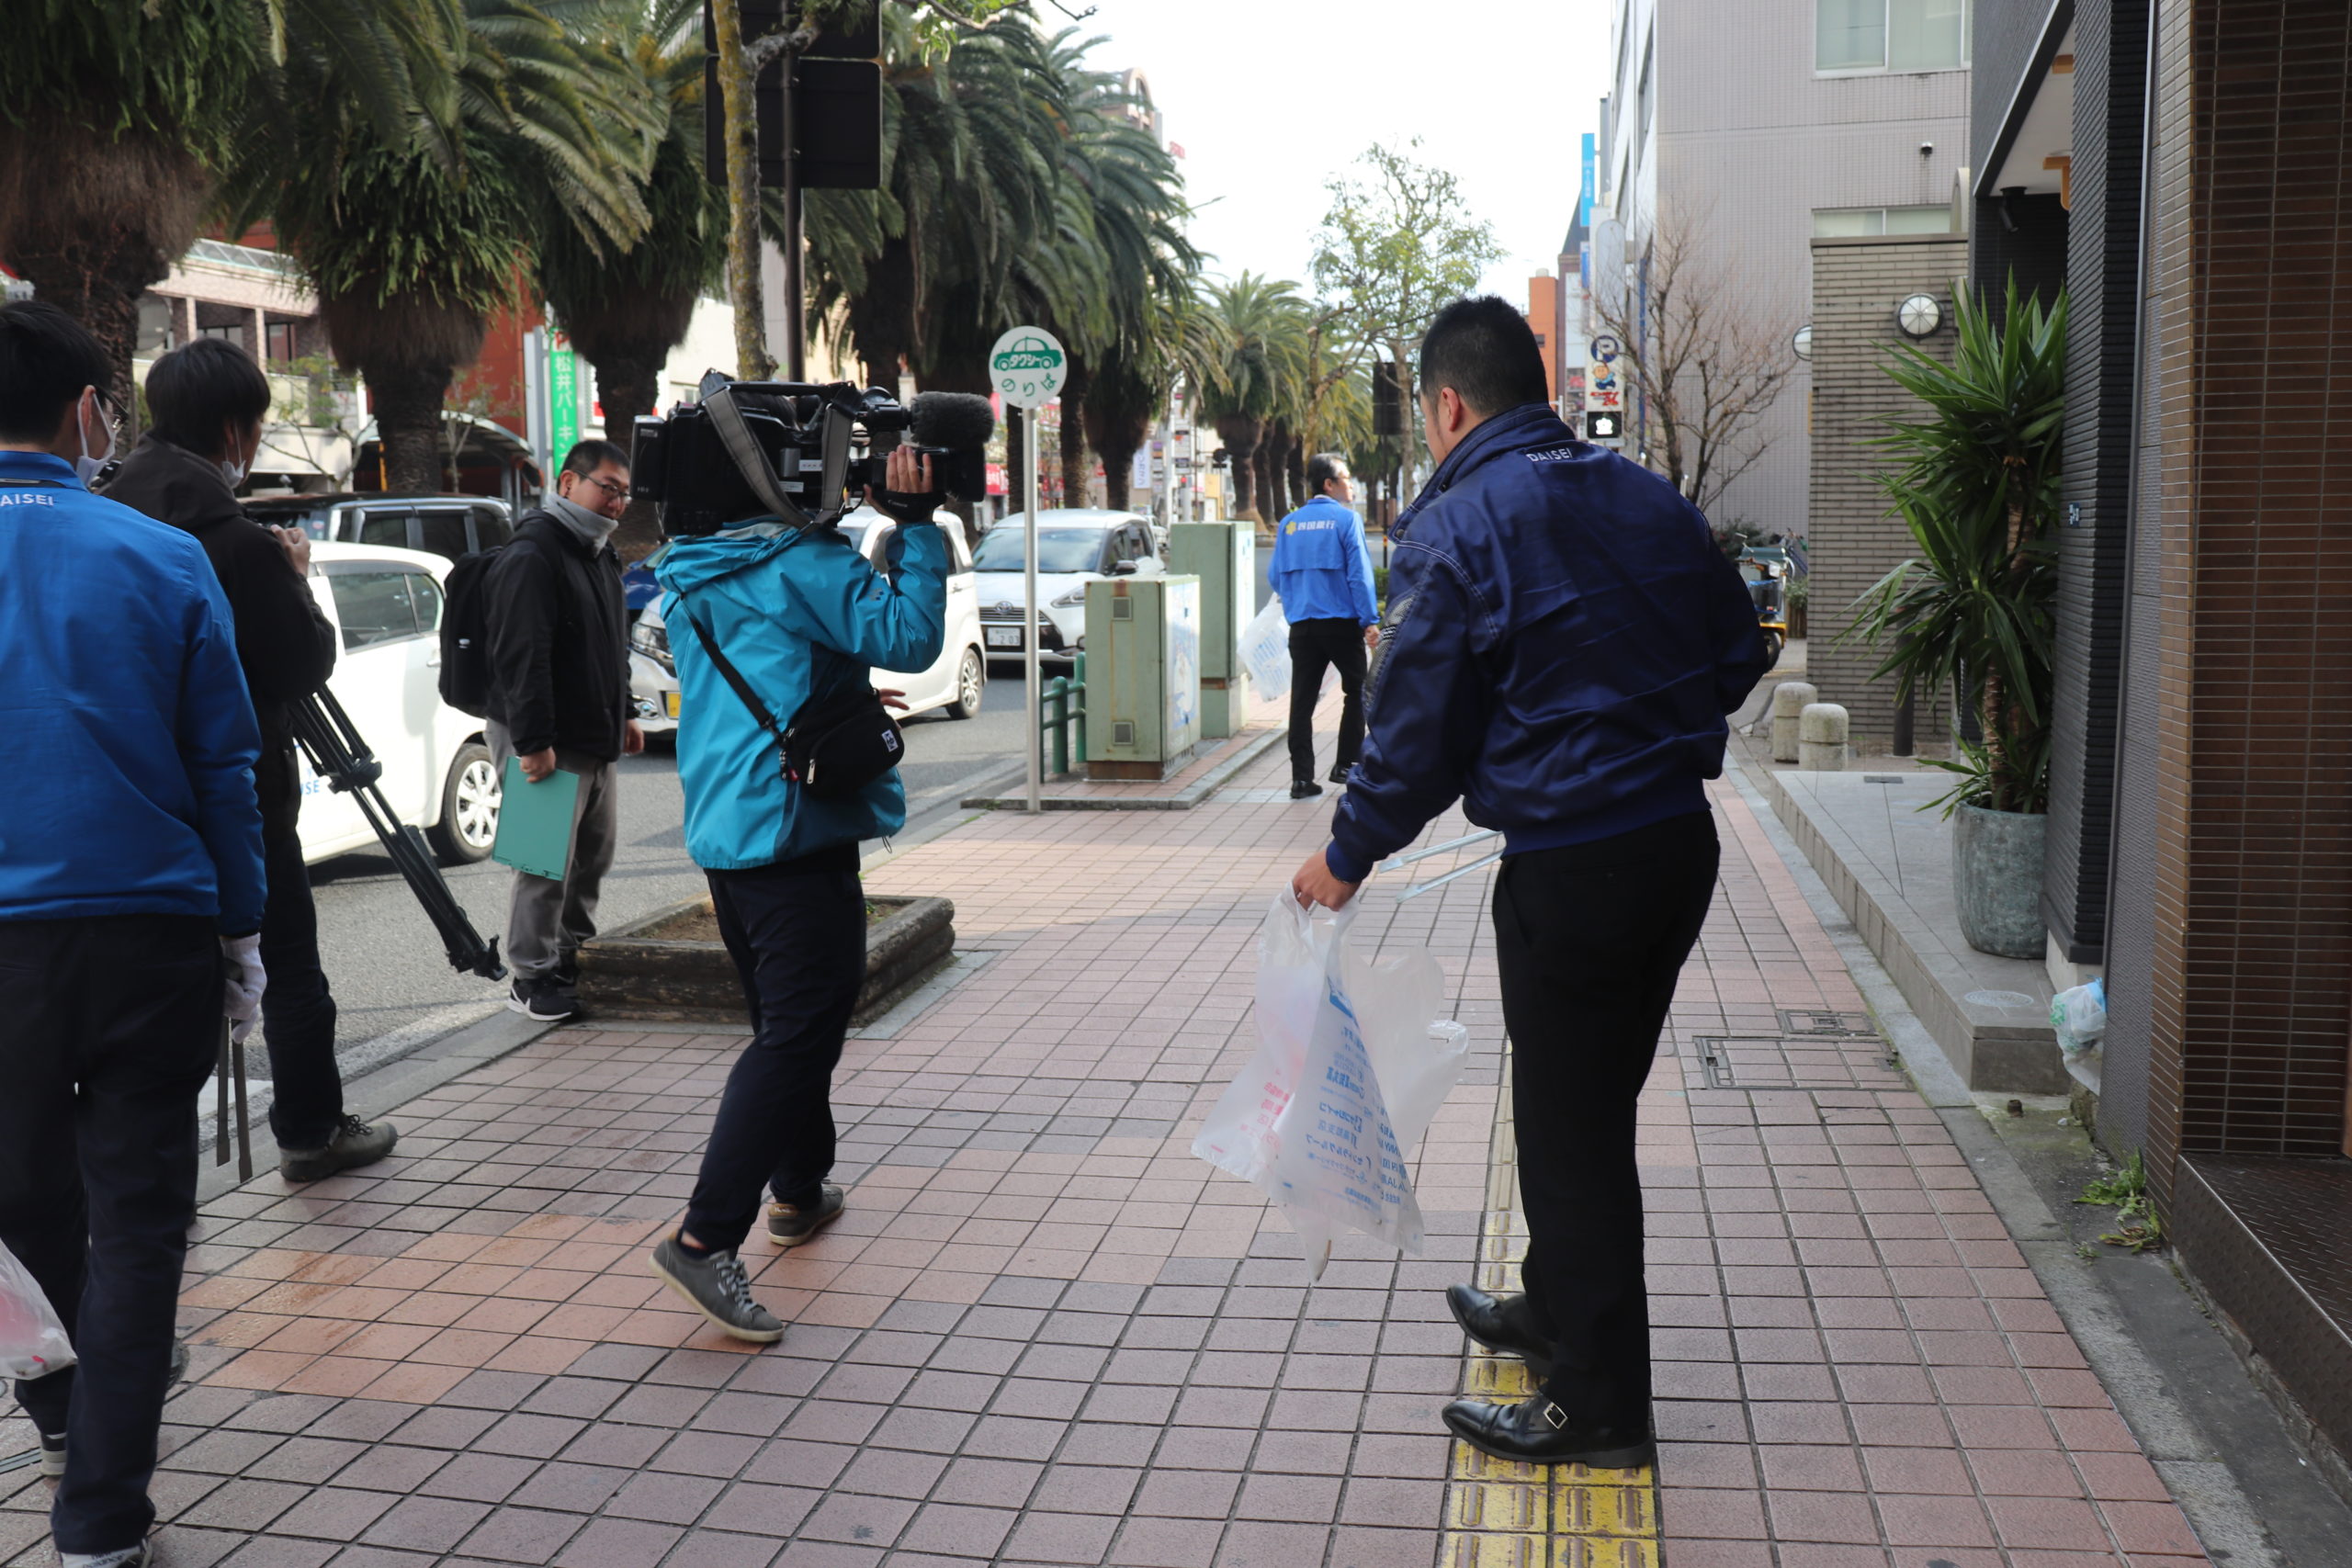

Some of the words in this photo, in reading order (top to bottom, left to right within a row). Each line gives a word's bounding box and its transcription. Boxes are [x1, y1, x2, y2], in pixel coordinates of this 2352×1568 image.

[1010, 354, 1042, 367] タクシー
[1001, 372, 1057, 398] のりば
[1525, 447, 1573, 462] DAISEI
